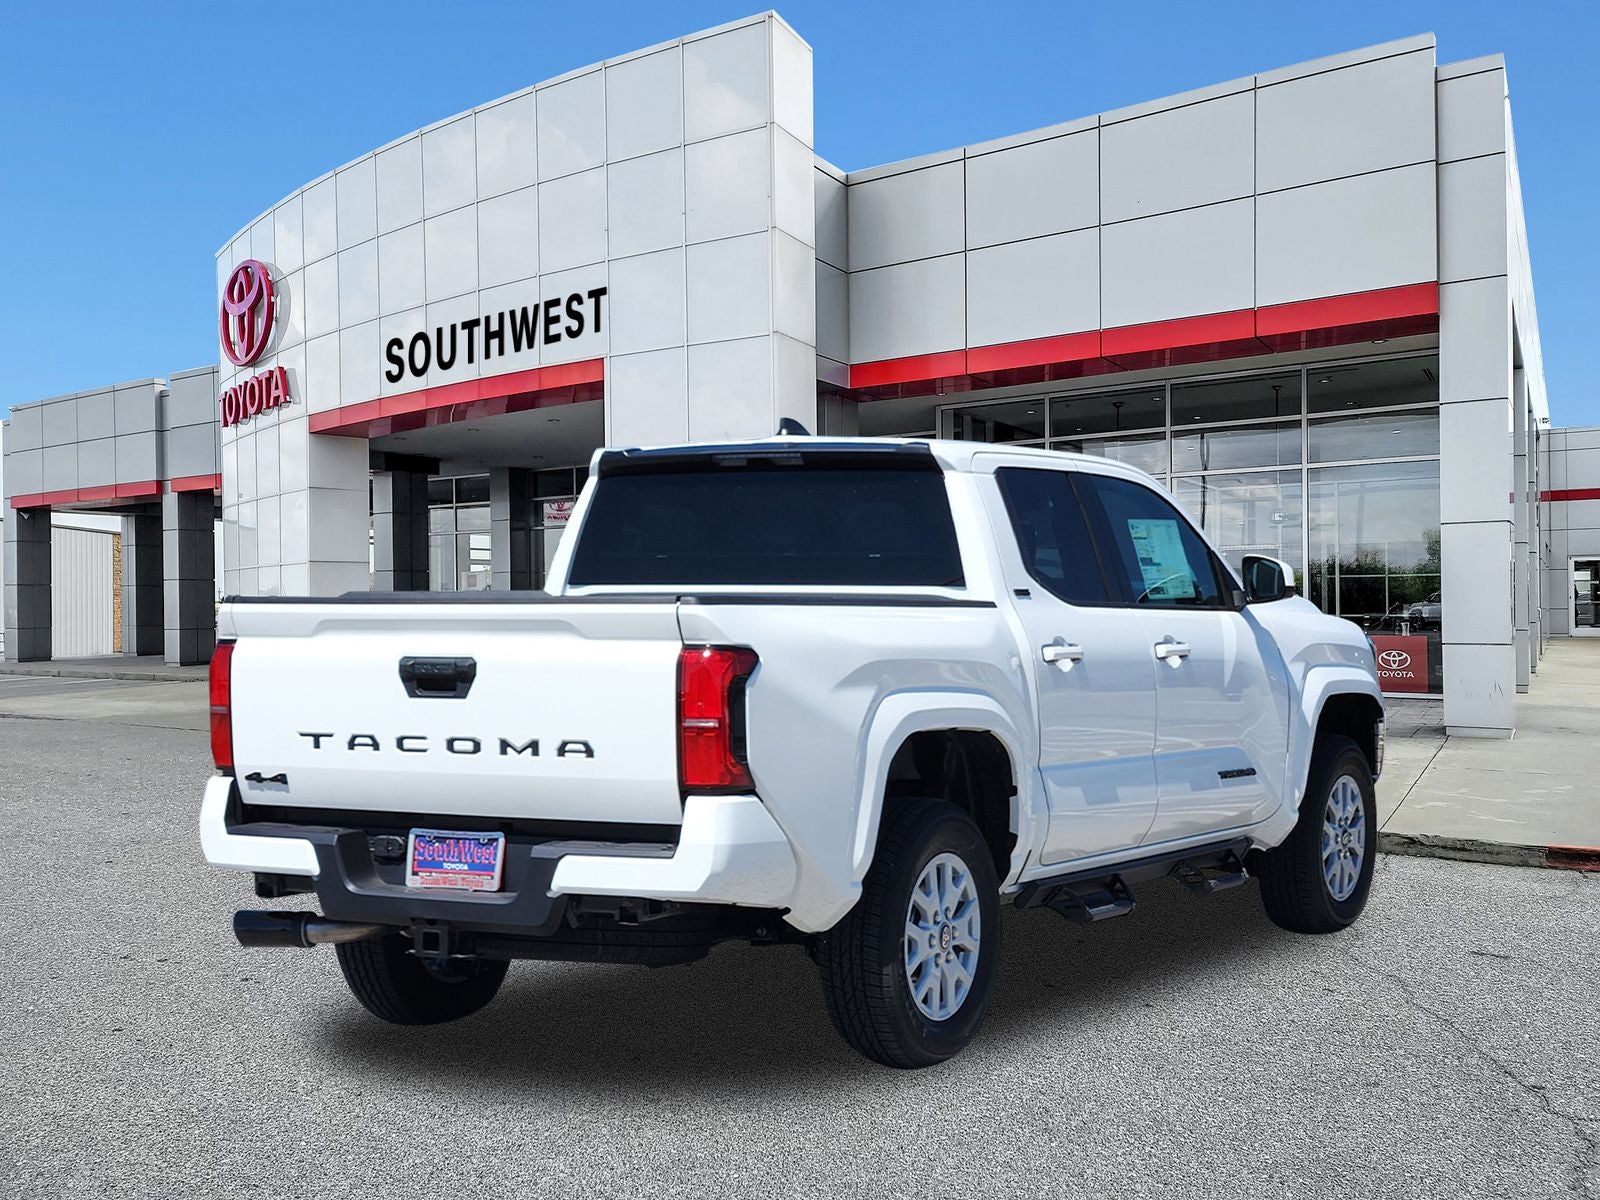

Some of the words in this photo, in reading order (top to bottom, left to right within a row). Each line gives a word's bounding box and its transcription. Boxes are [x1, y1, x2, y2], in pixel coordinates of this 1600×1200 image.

[385, 286, 608, 384] SOUTHWEST
[218, 366, 291, 428] TOYOTA
[1376, 670, 1415, 678] TOYOTA
[298, 731, 595, 758] TACOMA
[442, 862, 469, 871] TOYOTA
